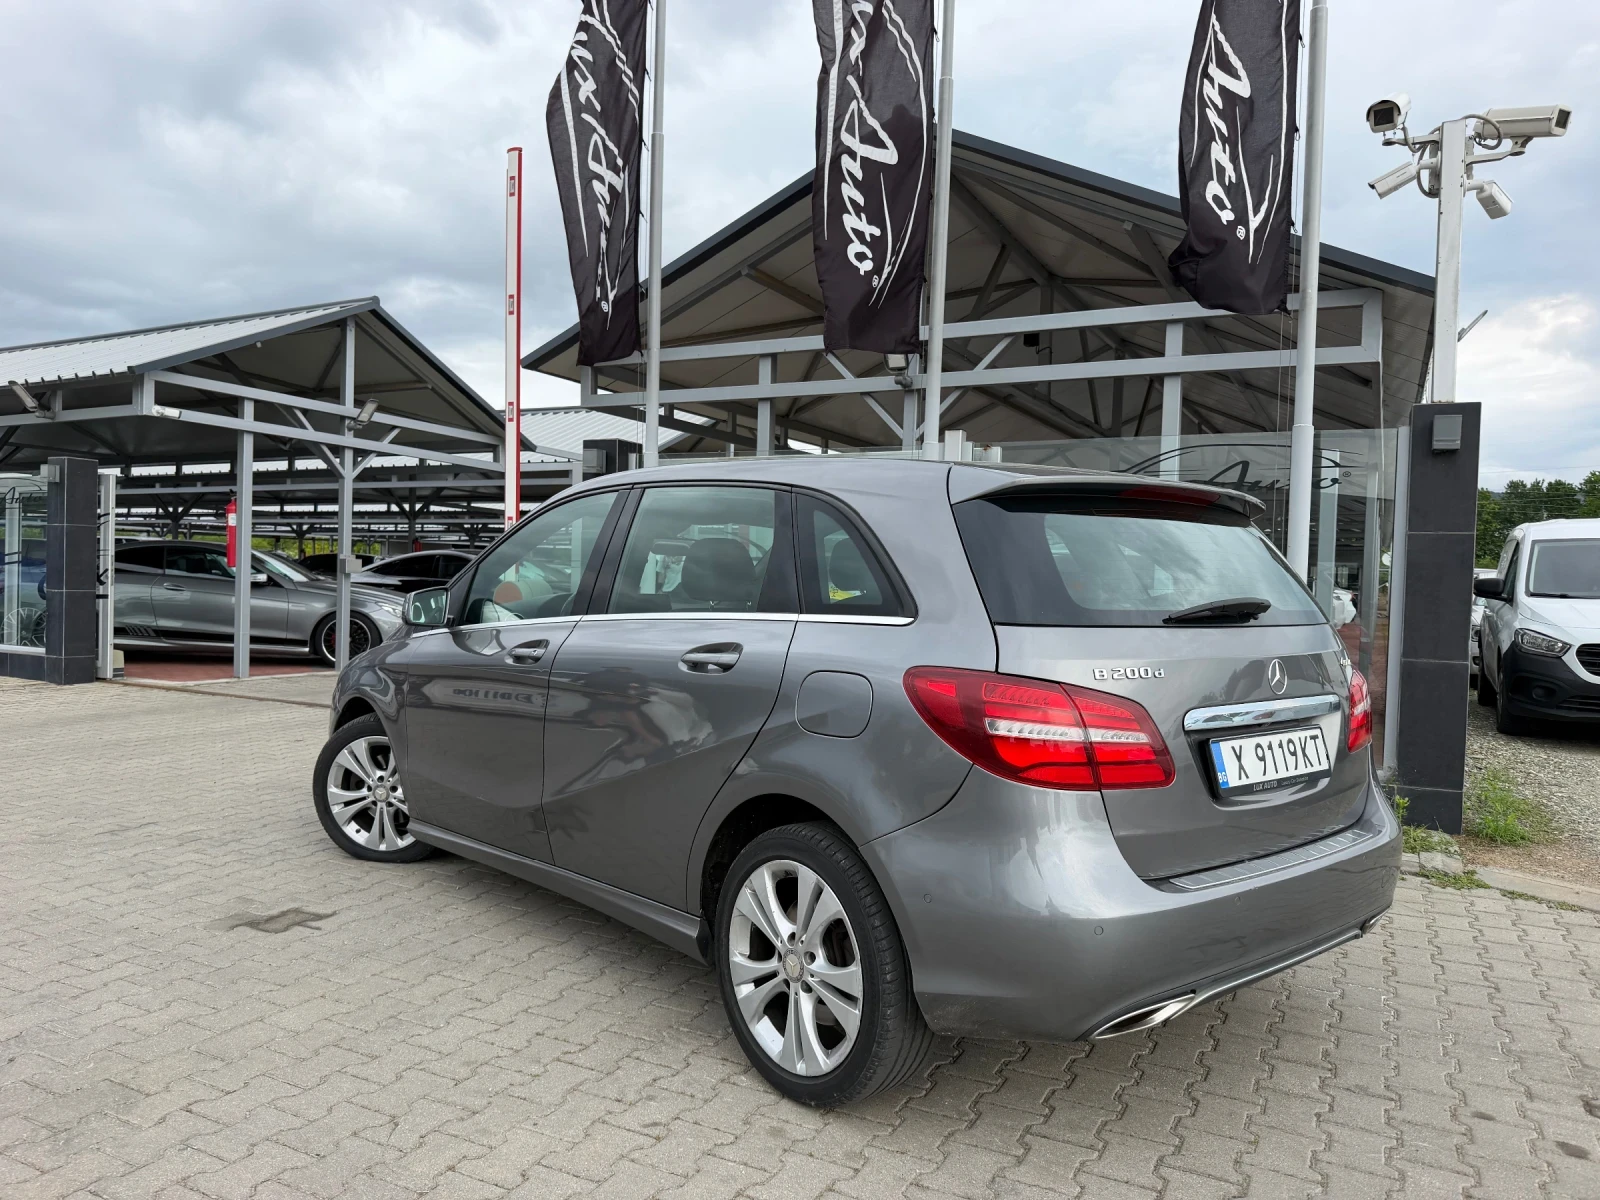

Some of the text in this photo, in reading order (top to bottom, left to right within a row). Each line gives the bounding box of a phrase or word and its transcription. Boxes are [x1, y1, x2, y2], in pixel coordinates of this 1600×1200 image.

[1203, 13, 1251, 225] Auto
[841, 74, 899, 275] Auto
[1190, 460, 1342, 491] Auo
[1092, 667, 1165, 680] B 200 d
[1217, 771, 1228, 783] BG
[1231, 745, 1249, 780] X
[1263, 780, 1278, 789] AUTO
